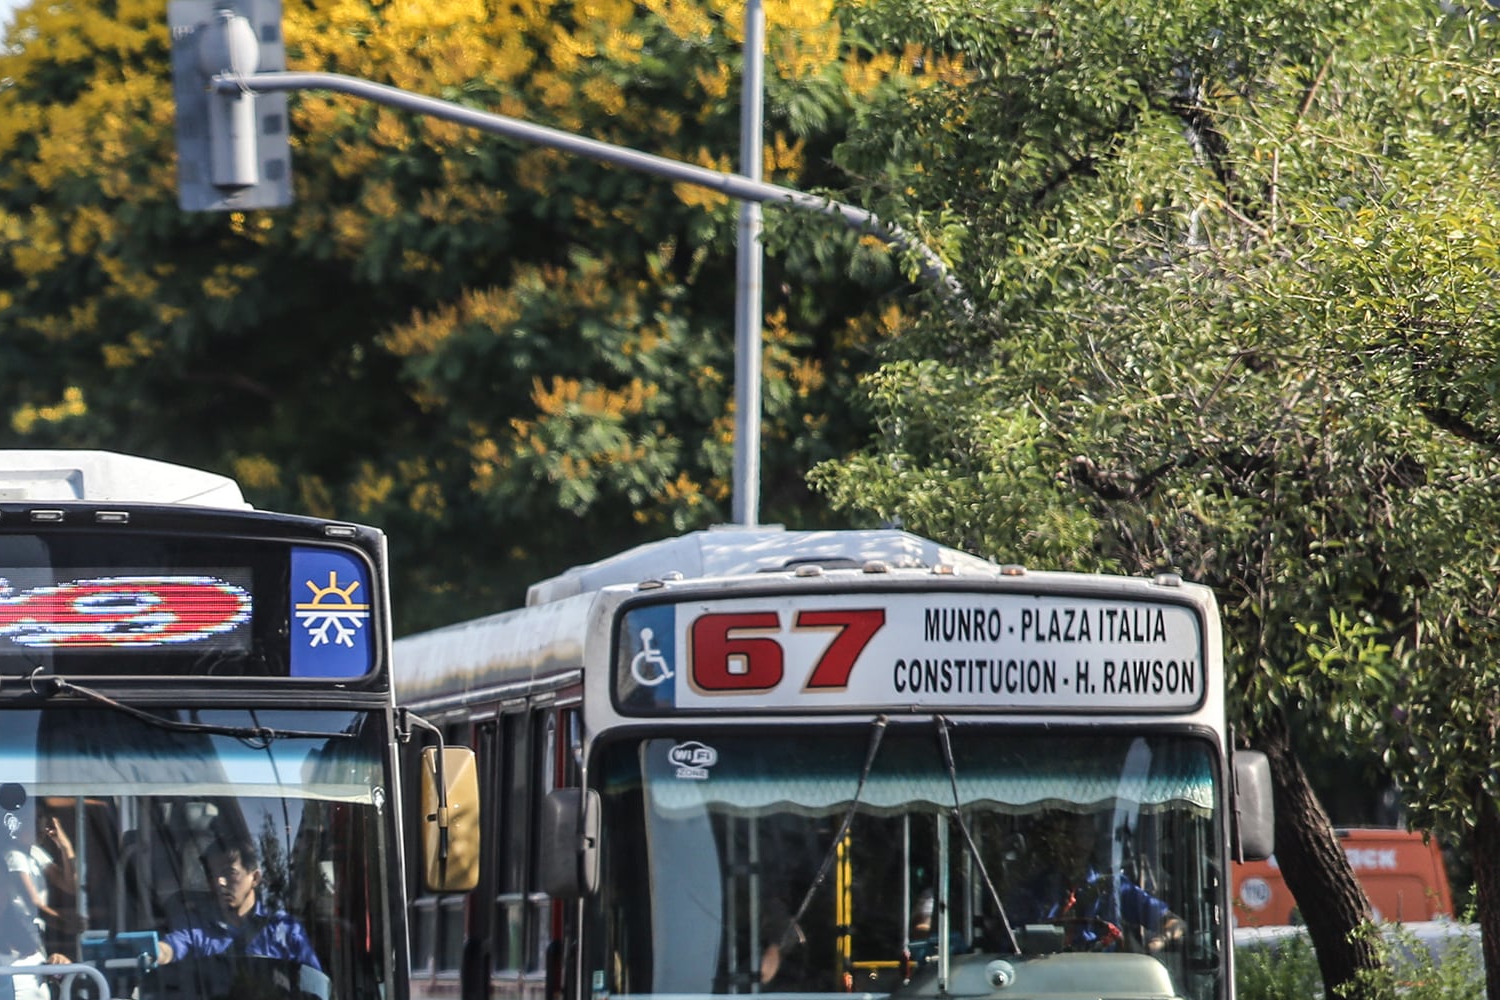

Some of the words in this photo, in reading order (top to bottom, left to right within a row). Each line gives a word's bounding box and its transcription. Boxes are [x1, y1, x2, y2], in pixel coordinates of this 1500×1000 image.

[924, 608, 1001, 643] MUNRO
[1021, 608, 1092, 643] PLAZA
[1099, 608, 1167, 643] ITALIA
[687, 607, 886, 697] 67
[893, 658, 1056, 694] CONSTITUCION
[1076, 660, 1096, 695] H.
[1102, 660, 1195, 695] RAWSON
